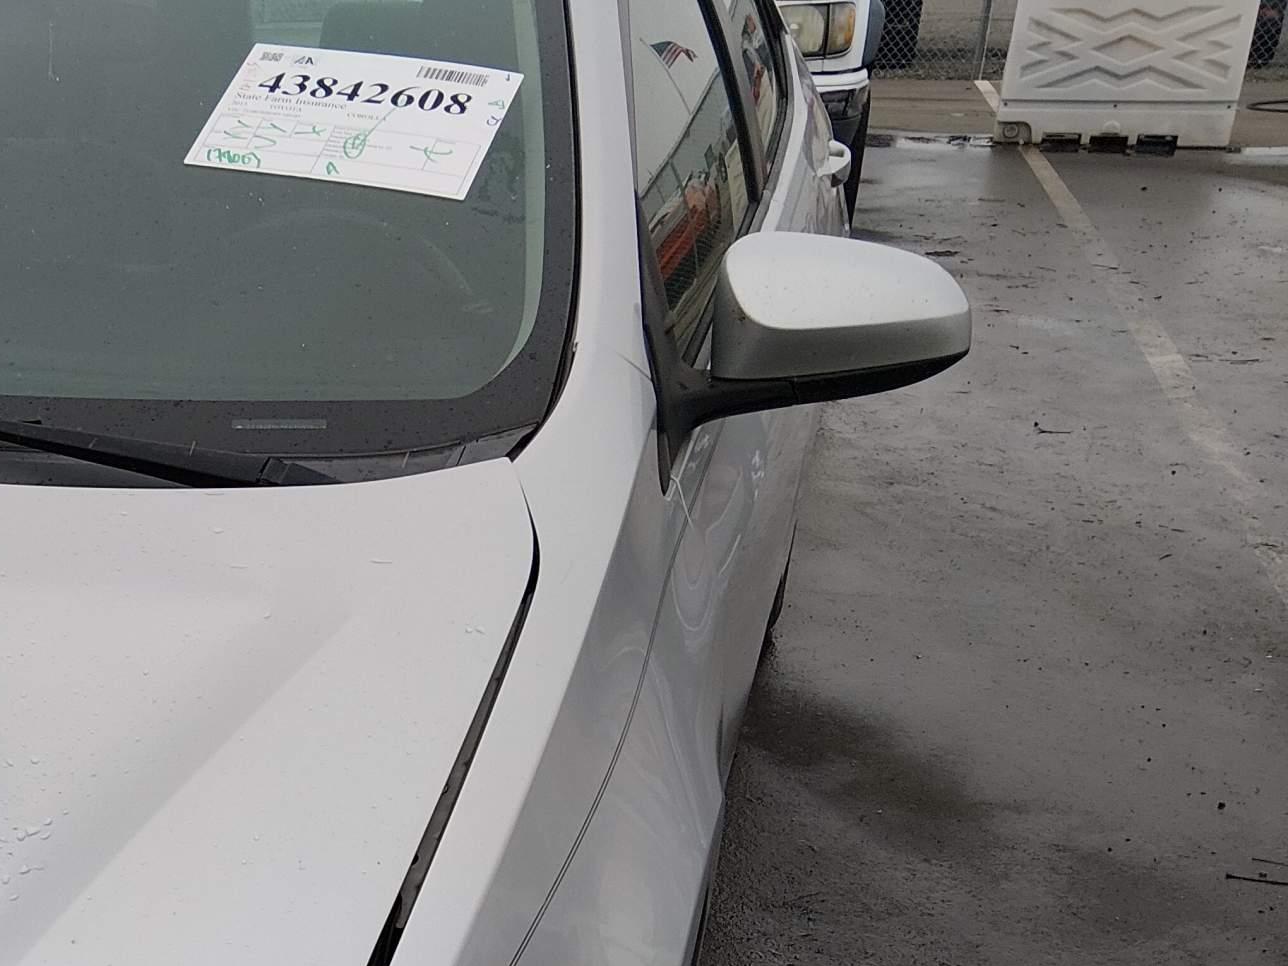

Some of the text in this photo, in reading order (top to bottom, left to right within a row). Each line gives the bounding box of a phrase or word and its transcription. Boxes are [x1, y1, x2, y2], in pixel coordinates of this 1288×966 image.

[234, 92, 347, 111] State Farm Insurance
[258, 72, 472, 115] 43842608
